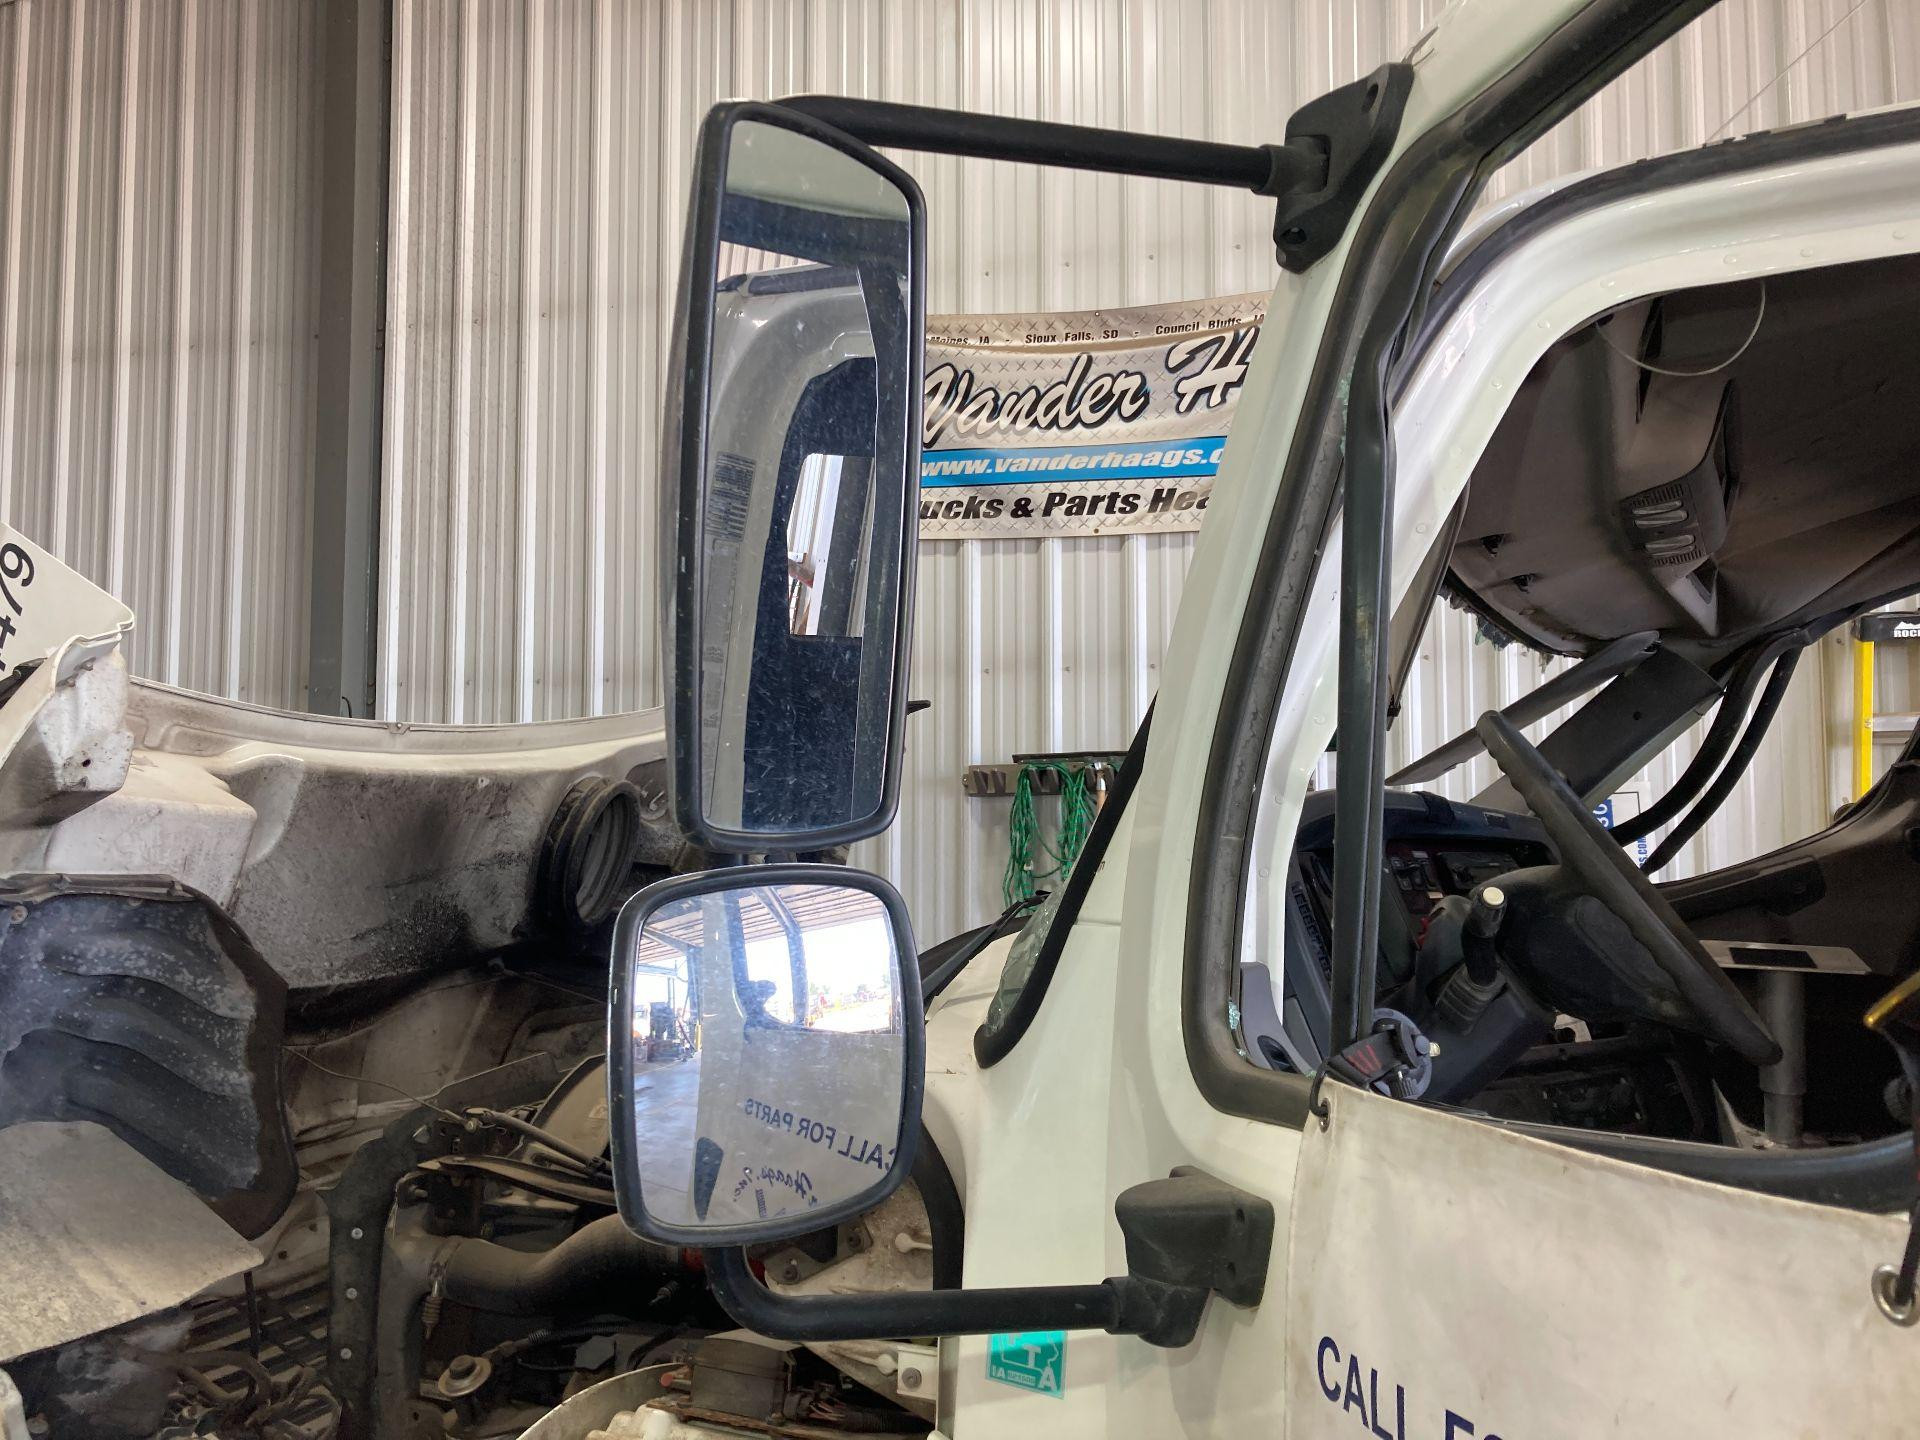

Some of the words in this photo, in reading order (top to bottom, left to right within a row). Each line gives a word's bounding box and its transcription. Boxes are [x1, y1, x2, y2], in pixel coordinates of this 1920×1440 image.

[1025, 333, 1057, 344] Sioux
[1064, 331, 1096, 342] Falls,
[1103, 329, 1119, 339] SD
[1155, 321, 1200, 336] Council
[922, 353, 1150, 449] Vander
[1164, 324, 1261, 415] H
[922, 448, 1225, 476] www.vanderhaags.c
[920, 495, 1004, 520] ucks
[1010, 496, 1035, 518] &
[1041, 490, 1141, 518] Parts
